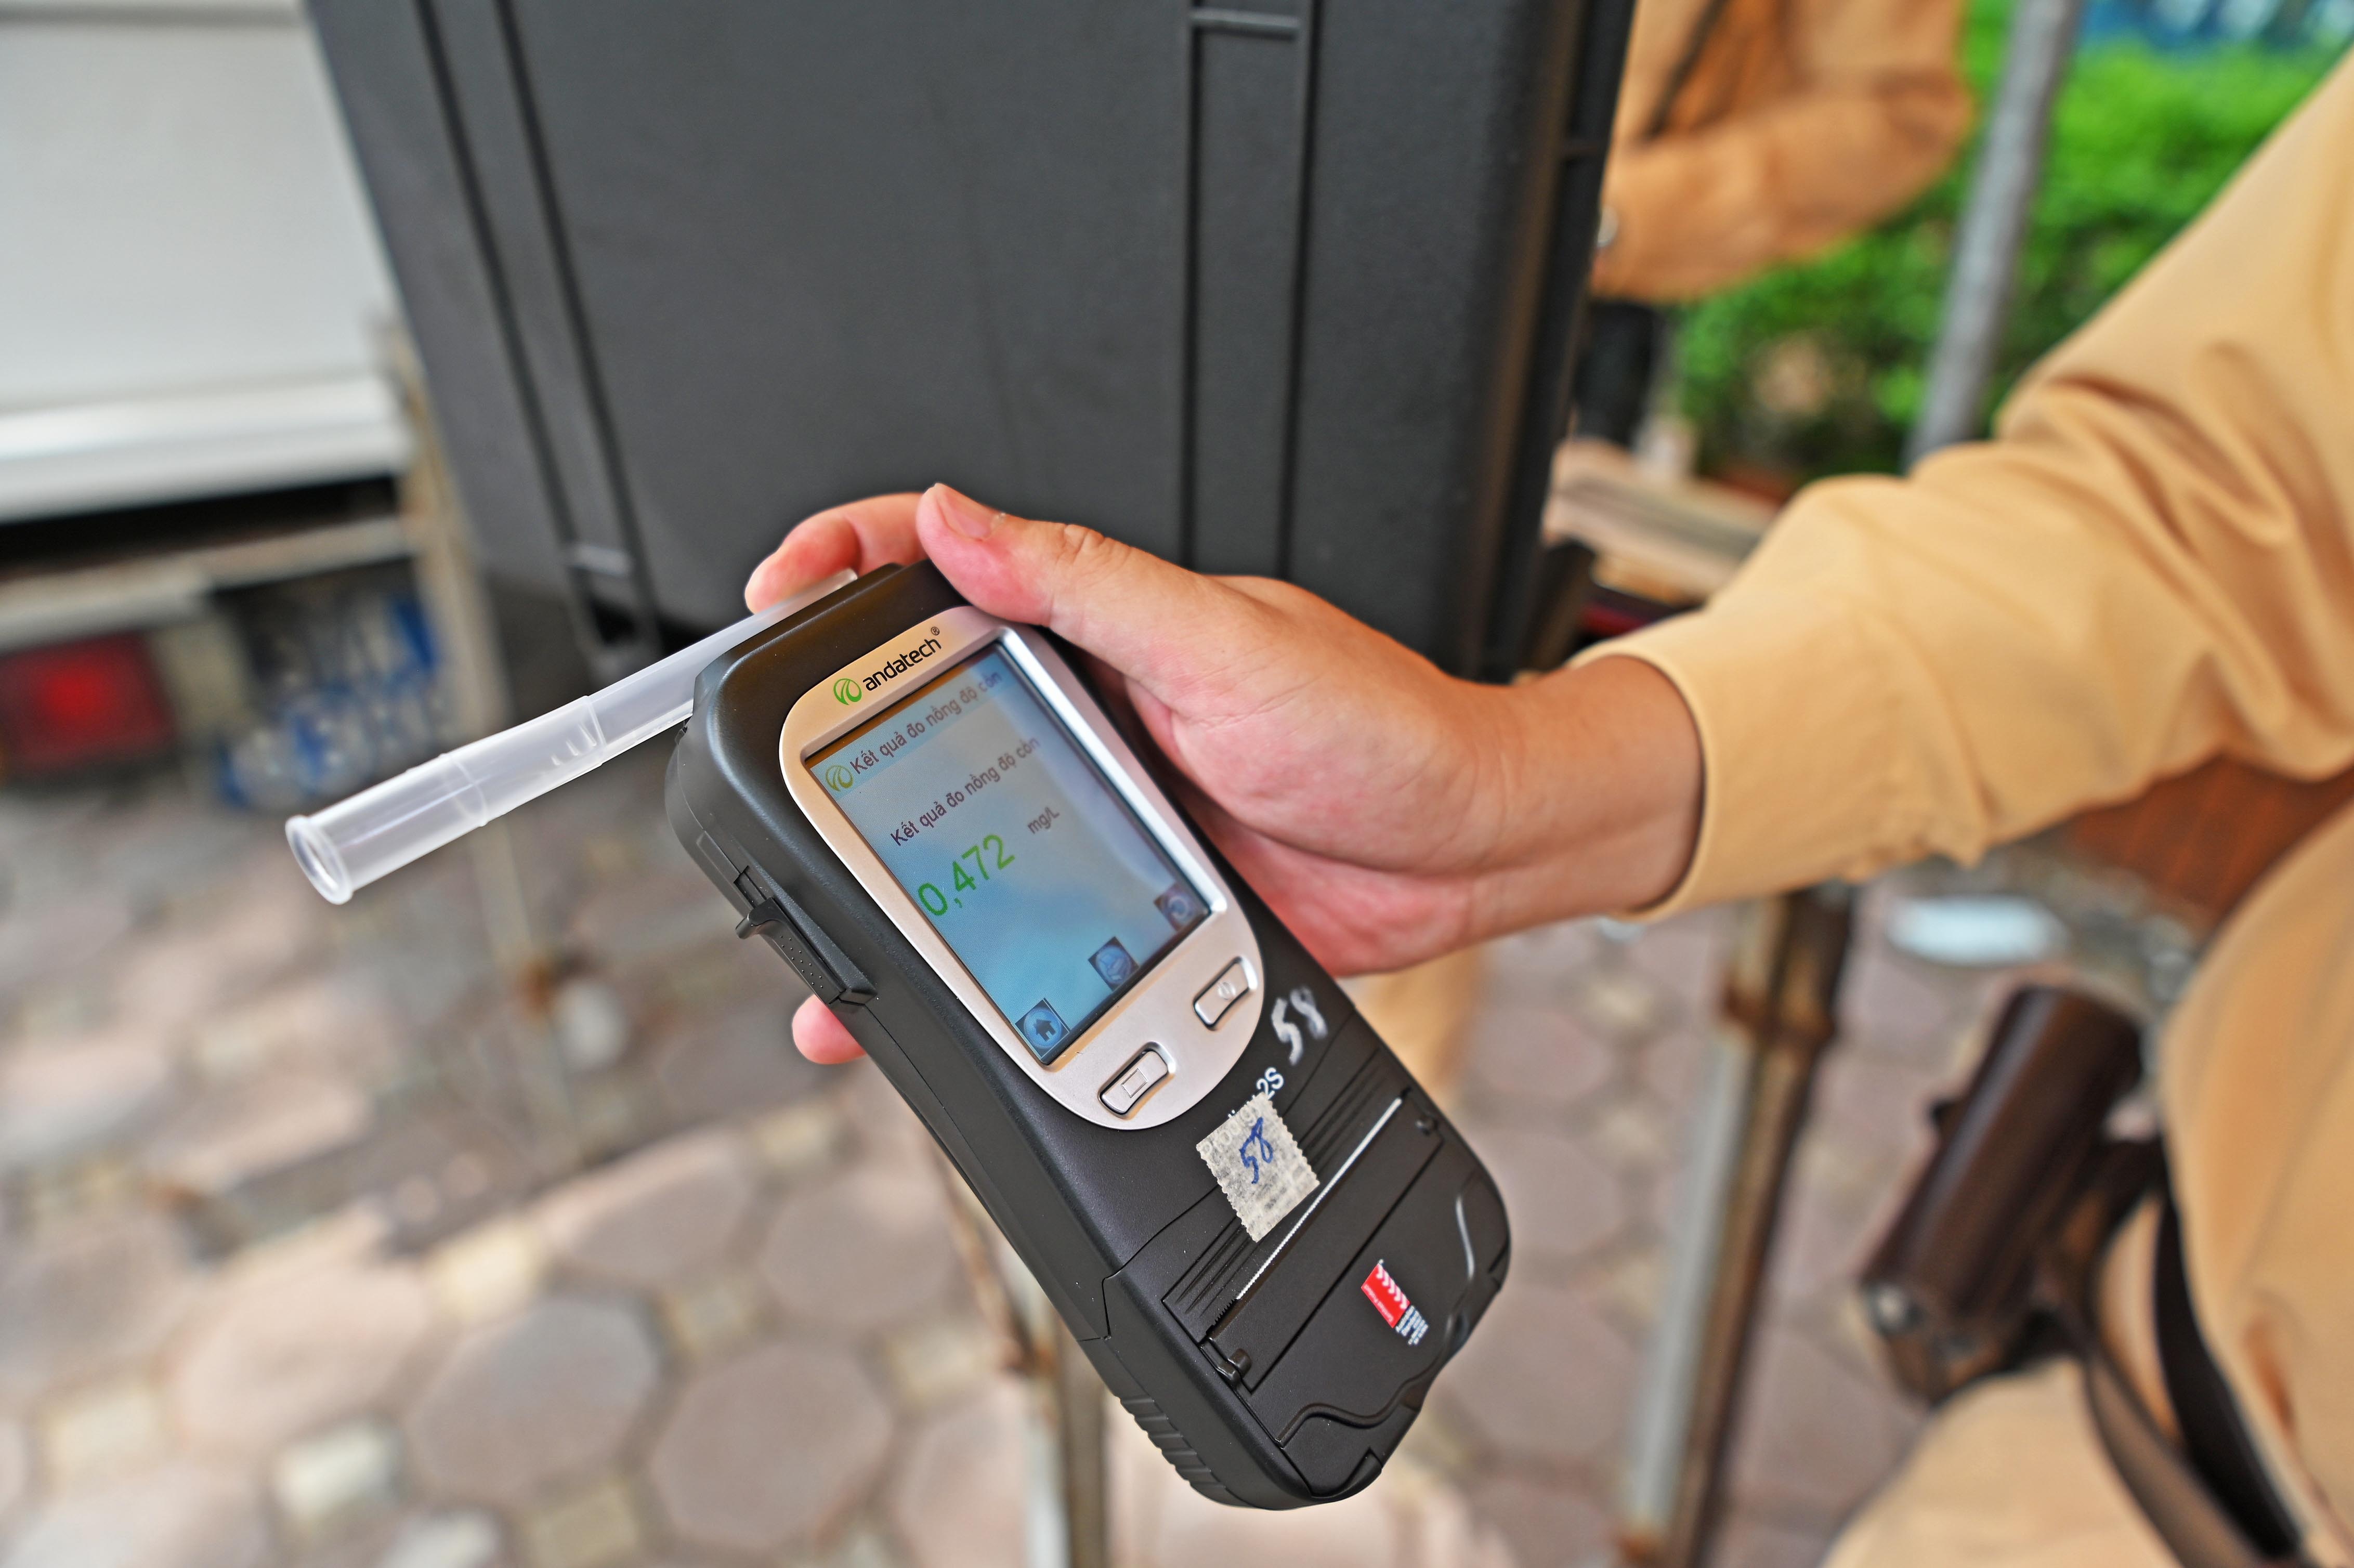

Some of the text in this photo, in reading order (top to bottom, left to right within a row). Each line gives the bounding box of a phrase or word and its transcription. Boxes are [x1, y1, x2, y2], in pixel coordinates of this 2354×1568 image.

[849, 750, 879, 774] Kết
[879, 731, 907, 758] quả
[906, 723, 926, 738] đo
[925, 699, 962, 727] nồng
[960, 685, 979, 703] độ
[890, 821, 920, 846] Kết
[919, 801, 947, 828] quả
[946, 791, 965, 807] đo
[964, 767, 1001, 795] nồng
[998, 752, 1016, 770] độ
[918, 806, 1060, 916] 0,472 mg/L
[1256, 1067, 1284, 1101] 2S
